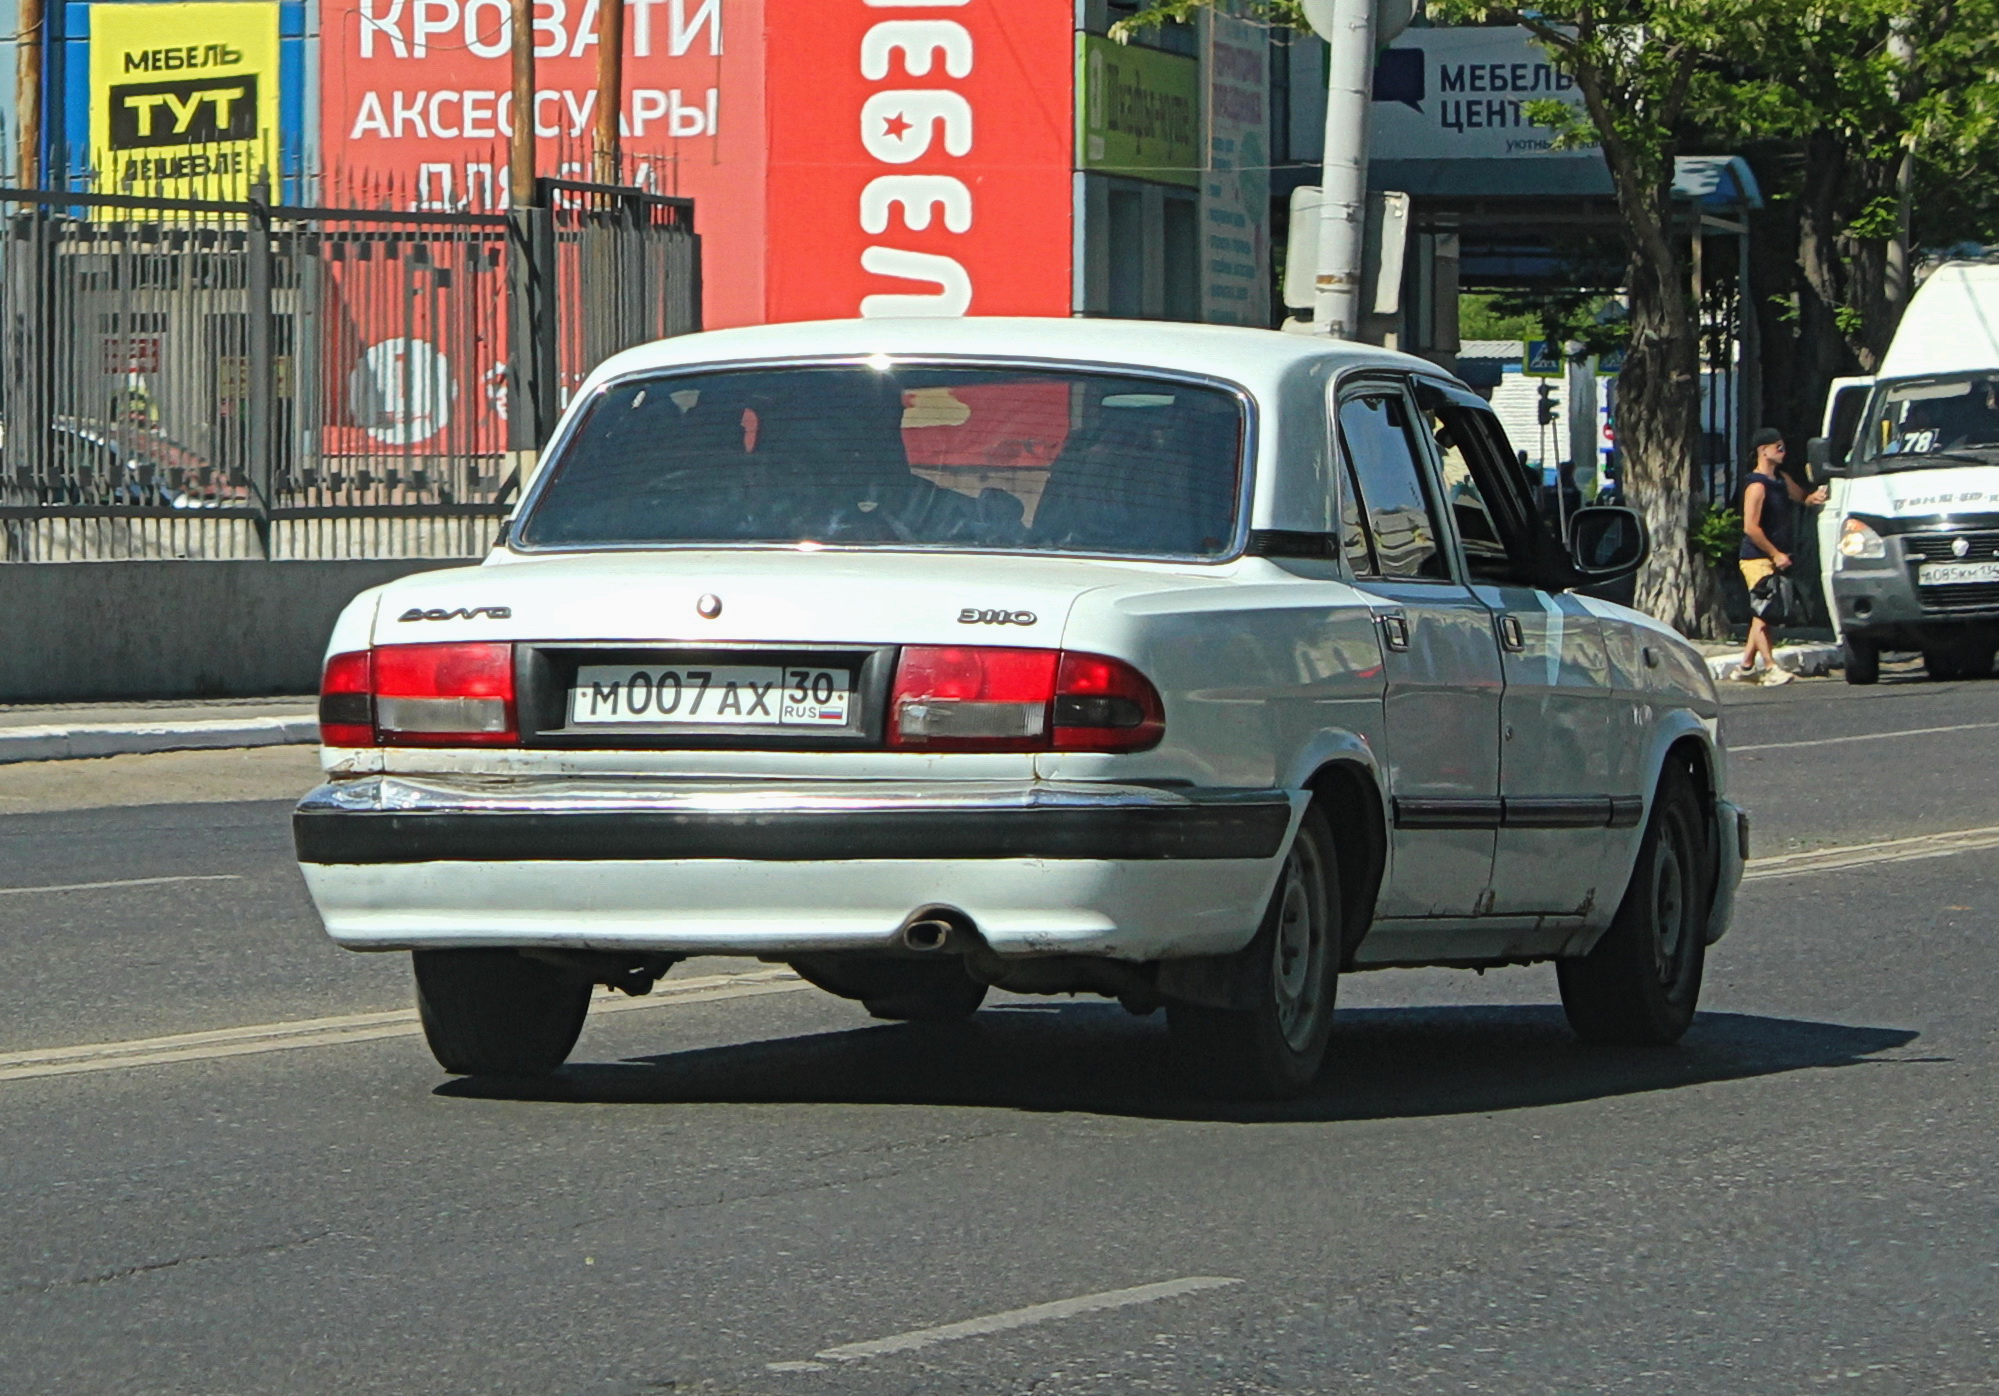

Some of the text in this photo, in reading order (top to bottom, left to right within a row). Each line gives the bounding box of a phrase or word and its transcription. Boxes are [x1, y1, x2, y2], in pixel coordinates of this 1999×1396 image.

[124, 44, 243, 74] МЕБЕЛЬ
[1440, 63, 1573, 92] МЕБЕЛЬ
[123, 86, 245, 137] ТУТ
[349, 88, 719, 139] АКСЕССУРЫ
[1440, 99, 1545, 133] ЦЕНТ
[1901, 431, 1934, 453] 78
[957, 608, 1038, 626] 3110
[590, 670, 834, 716] М007АХ 30
[784, 705, 817, 719] RUS
